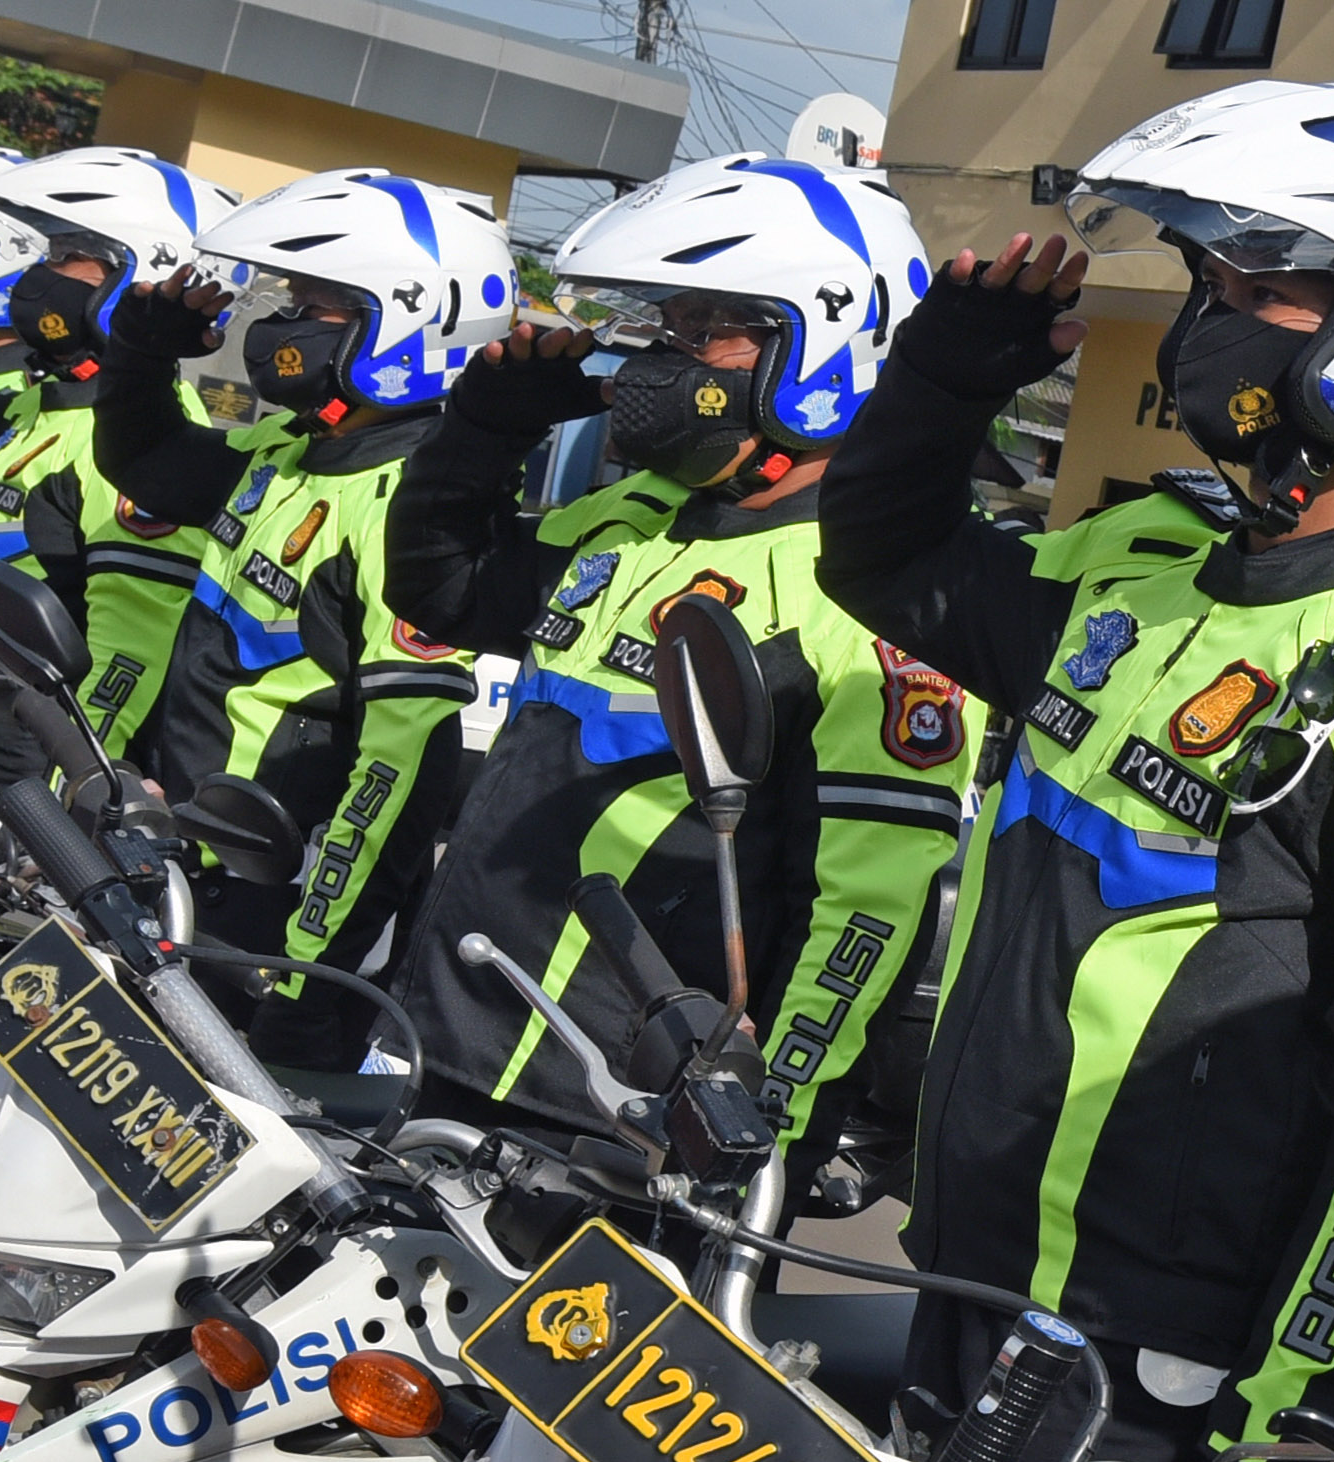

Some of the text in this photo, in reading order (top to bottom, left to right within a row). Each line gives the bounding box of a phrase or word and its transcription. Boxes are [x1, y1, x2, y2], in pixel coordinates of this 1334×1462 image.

[816, 124, 839, 149] BRI
[1236, 412, 1282, 437] POLRI
[245, 553, 296, 604] POLISI
[609, 638, 656, 680] POLI
[905, 673, 951, 689] BANTEN
[87, 652, 147, 746] ISI
[1120, 745, 1214, 826] POLISI
[296, 759, 401, 938] POLISI
[758, 910, 897, 1131] POLISI
